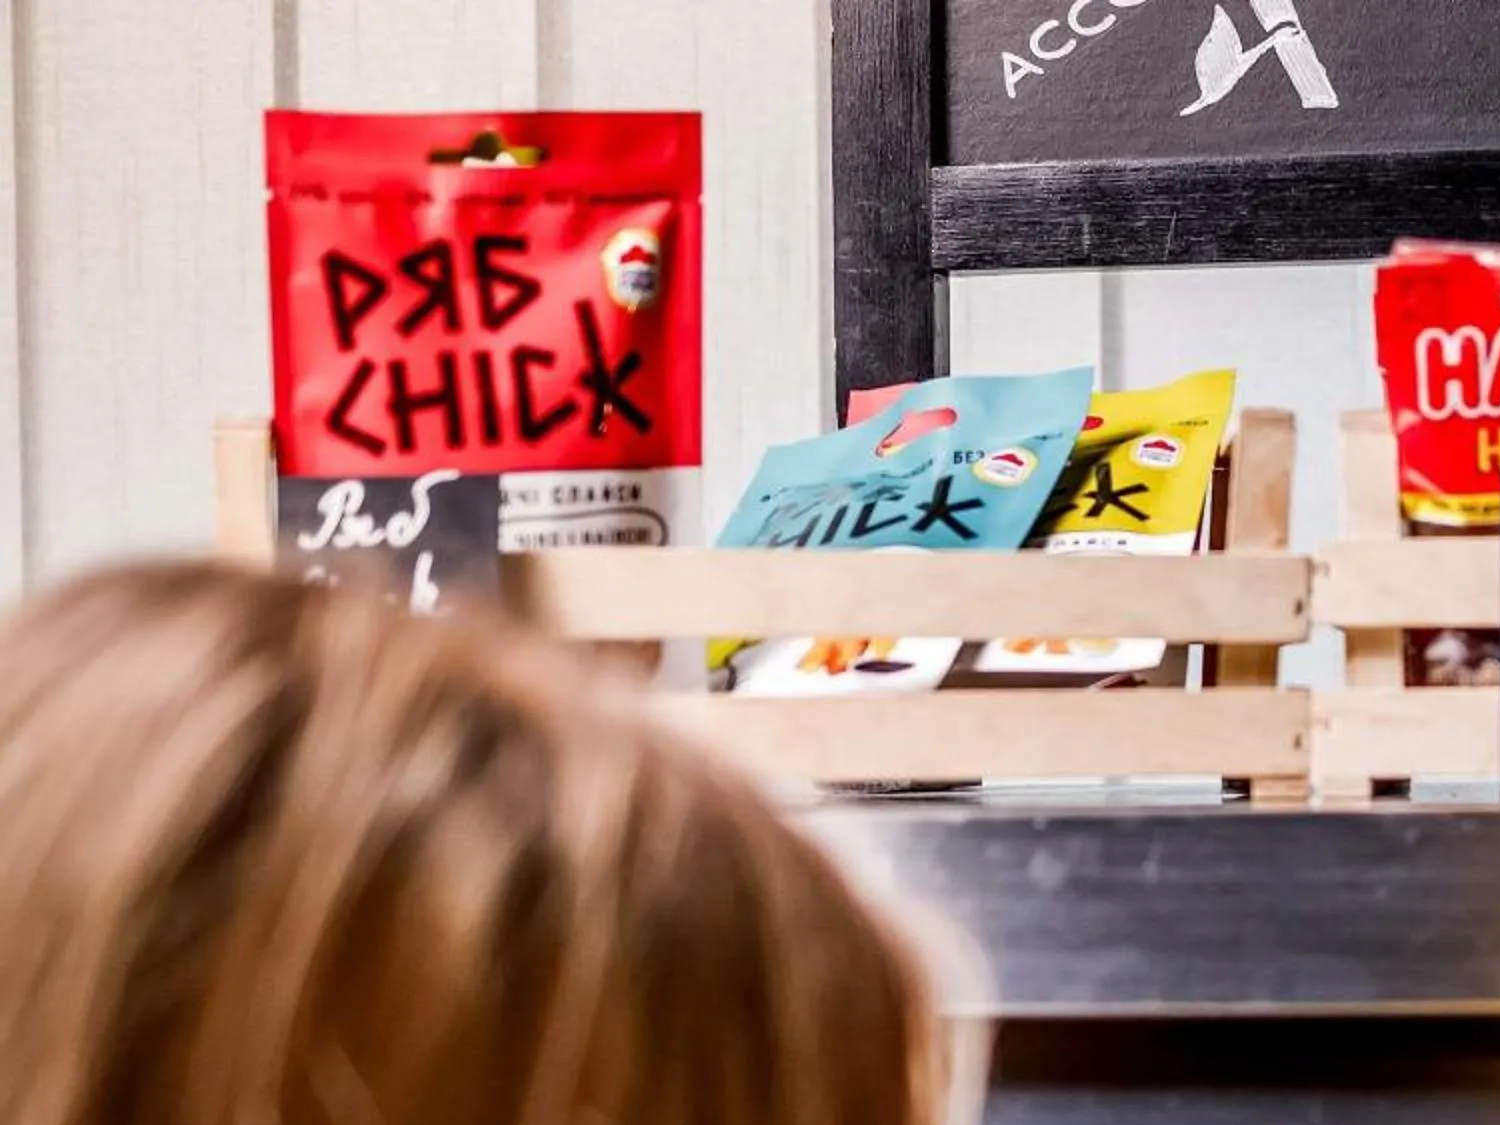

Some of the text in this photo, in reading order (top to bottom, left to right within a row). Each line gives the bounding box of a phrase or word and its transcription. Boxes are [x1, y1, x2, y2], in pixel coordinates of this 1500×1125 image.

[1002, 0, 1146, 99] ACC
[320, 236, 541, 352] РЯБ
[326, 299, 652, 457] CHICK
